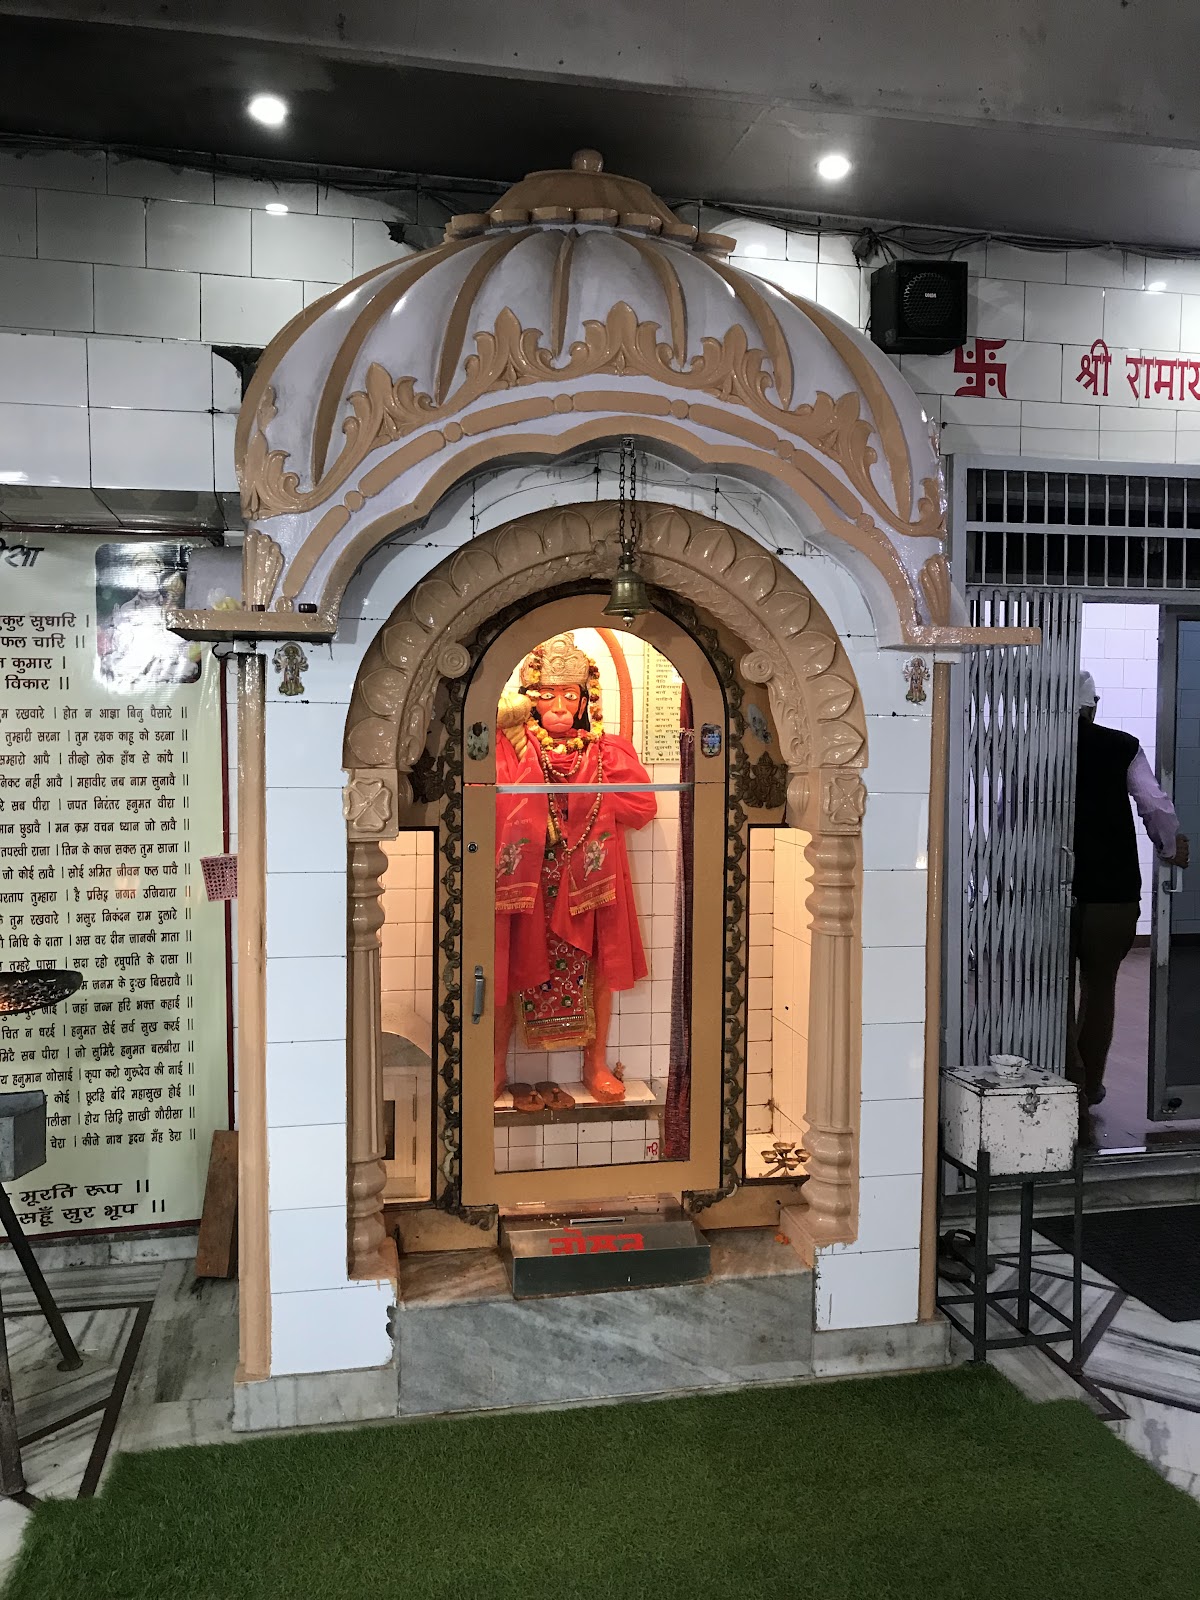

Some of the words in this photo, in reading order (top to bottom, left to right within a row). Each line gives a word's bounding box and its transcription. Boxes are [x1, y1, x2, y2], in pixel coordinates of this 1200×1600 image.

[1076, 338, 1112, 397] श्री
[29, 612, 76, 632] सुधारि
[32, 633, 66, 648] चारि
[11, 657, 53, 674] कुमार
[5, 674, 50, 690] विकार
[16, 706, 44, 719] रखवारे
[63, 706, 78, 720] होत
[85, 709, 92, 718] न
[127, 705, 144, 723] बिनु
[151, 704, 172, 718] पैसारे
[5, 728, 32, 746] तुम्हारी
[37, 732, 60, 742] सरना
[75, 732, 89, 746] तुम
[94, 732, 113, 741] रक्षक
[118, 732, 134, 745] काहू
[139, 728, 149, 740] को
[155, 731, 175, 741] डरना
[34, 750, 50, 764] आपै
[96, 751, 114, 764] लोक
[142, 751, 150, 764] से
[46, 773, 63, 787] आवै
[77, 773, 106, 788] महावीर
[111, 777, 125, 786] जब
[130, 777, 147, 786] नाम
[152, 772, 176, 790] सुनावै
[11, 801, 26, 811] सब
[32, 797, 50, 811] पीरा
[67, 800, 88, 810] जपत
[94, 796, 120, 809] निरंतर
[126, 799, 151, 813] हनुमत
[55, 823, 70, 832] मन
[94, 822, 114, 832] वचन
[120, 822, 140, 831] ध्यान
[144, 818, 156, 831] जो
[160, 817, 177, 831] लावै
[31, 846, 50, 856] राजा
[62, 842, 78, 855] तिन
[82, 842, 90, 855] के
[93, 845, 111, 854] काज
[115, 845, 136, 854] सकल
[140, 844, 154, 858] तुम
[157, 843, 178, 853] साजा
[2, 867, 14, 879] जो
[18, 865, 34, 880] कोई
[38, 865, 55, 879] लावै
[68, 864, 84, 878] सोई
[89, 864, 112, 877] अमित
[116, 863, 140, 876] जीवन
[144, 866, 159, 876] फल
[163, 861, 178, 875] पावै
[30, 892, 57, 906] तुम्हारा
[74, 887, 80, 902] है
[115, 890, 136, 899] जगत
[143, 885, 177, 898] उजियारा
[9, 916, 24, 930] तुम
[30, 911, 59, 925] रखवारे
[76, 913, 96, 927] असुर
[102, 908, 131, 922] निकंदन
[137, 911, 152, 921] राम
[158, 907, 177, 924] दुलारे
[9, 934, 29, 948] निधि
[33, 934, 41, 946] के
[45, 937, 63, 947] दाता
[76, 936, 91, 945] अस
[95, 935, 106, 945] वर
[110, 931, 125, 944] दीन
[129, 929, 157, 943] जानकी
[161, 932, 180, 942] माता
[73, 958, 89, 969] सदा
[95, 954, 108, 968] रहो
[114, 952, 141, 971] रघुपति
[146, 952, 154, 965] के
[160, 955, 178, 965] दासा
[92, 980, 114, 989] जनम
[118, 976, 126, 988] के
[150, 972, 181, 987] बिसरावै
[94, 1002, 113, 1012] जन्म
[118, 997, 131, 1012] हरि
[160, 995, 180, 1010] कहाई
[2, 1026, 19, 1039] चित
[25, 1028, 33, 1037] न
[39, 1023, 55, 1037] धरई
[71, 1025, 96, 1040] हनुमत
[102, 1020, 115, 1034] सेई
[121, 1019, 135, 1033] सर्व
[141, 1022, 158, 1036] सुख
[163, 1017, 180, 1031] करई
[21, 1051, 36, 1061] सब
[42, 1046, 59, 1059] पीरा
[75, 1045, 86, 1057] जो
[92, 1042, 115, 1061] सुमिरै
[121, 1045, 145, 1059] हनुमत
[12, 1073, 42, 1088] हनुमान
[84, 1069, 101, 1083] कृपा
[105, 1065, 120, 1078] करो
[154, 1062, 164, 1075] की
[54, 1089, 69, 1104] कोई
[111, 1086, 125, 1100] बंदि
[131, 1088, 162, 1102] महासुख
[168, 1083, 181, 1098] होई
[84, 1111, 100, 1125] होय
[128, 1107, 150, 1121] साखी
[155, 1106, 183, 1119] गौरीसा
[50, 1136, 66, 1148] चेरा
[106, 1135, 123, 1144] नाथ
[169, 1129, 182, 1141] डेरा
[19, 1183, 78, 1207] मूरति
[84, 1183, 122, 1197] रूप
[61, 1207, 96, 1223] सुर
[104, 1204, 138, 1220] भूप
